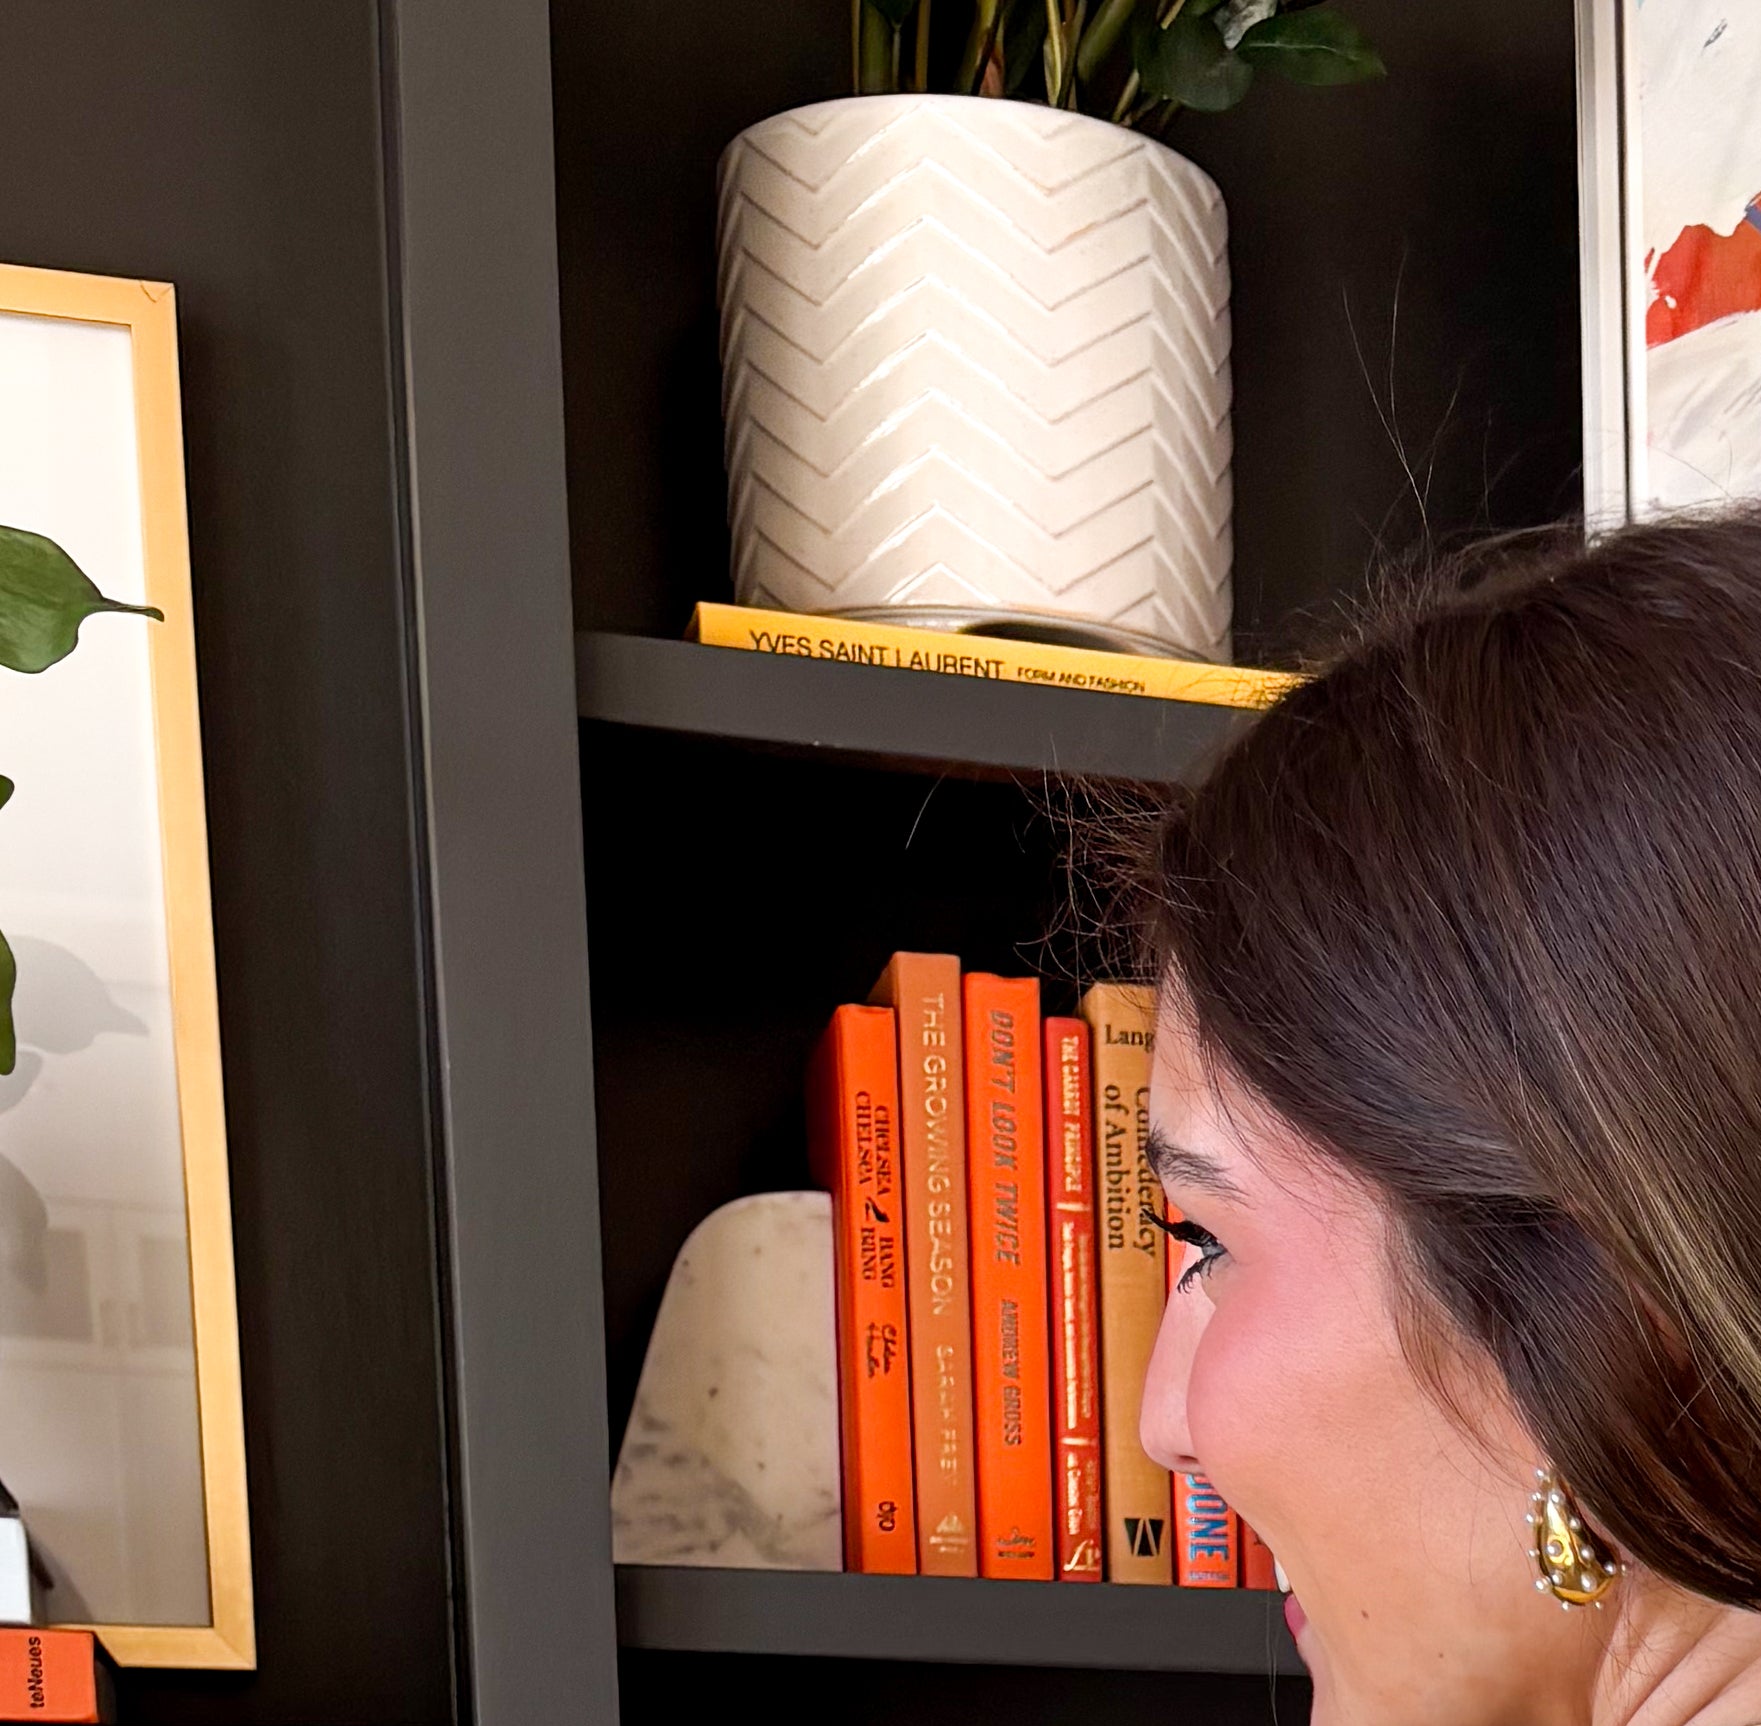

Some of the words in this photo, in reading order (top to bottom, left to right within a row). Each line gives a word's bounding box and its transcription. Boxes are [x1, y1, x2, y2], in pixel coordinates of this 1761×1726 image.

[750, 630, 811, 657] YVES
[819, 639, 891, 666] SAINT
[895, 647, 1006, 679] LAURENT
[921, 993, 946, 1047] THE
[991, 1010, 1015, 1095] DON'T
[1105, 1024, 1155, 1053] Lang
[924, 1054, 950, 1194] GROWING
[992, 1102, 1018, 1170] LOOK
[1105, 1084, 1130, 1116] of
[1105, 1119, 1130, 1250] Ambition
[928, 1201, 953, 1316] SEASON
[995, 1182, 1020, 1268] TWICE
[1001, 1299, 1019, 1380] ANDREW
[1003, 1385, 1022, 1447] GROSS
